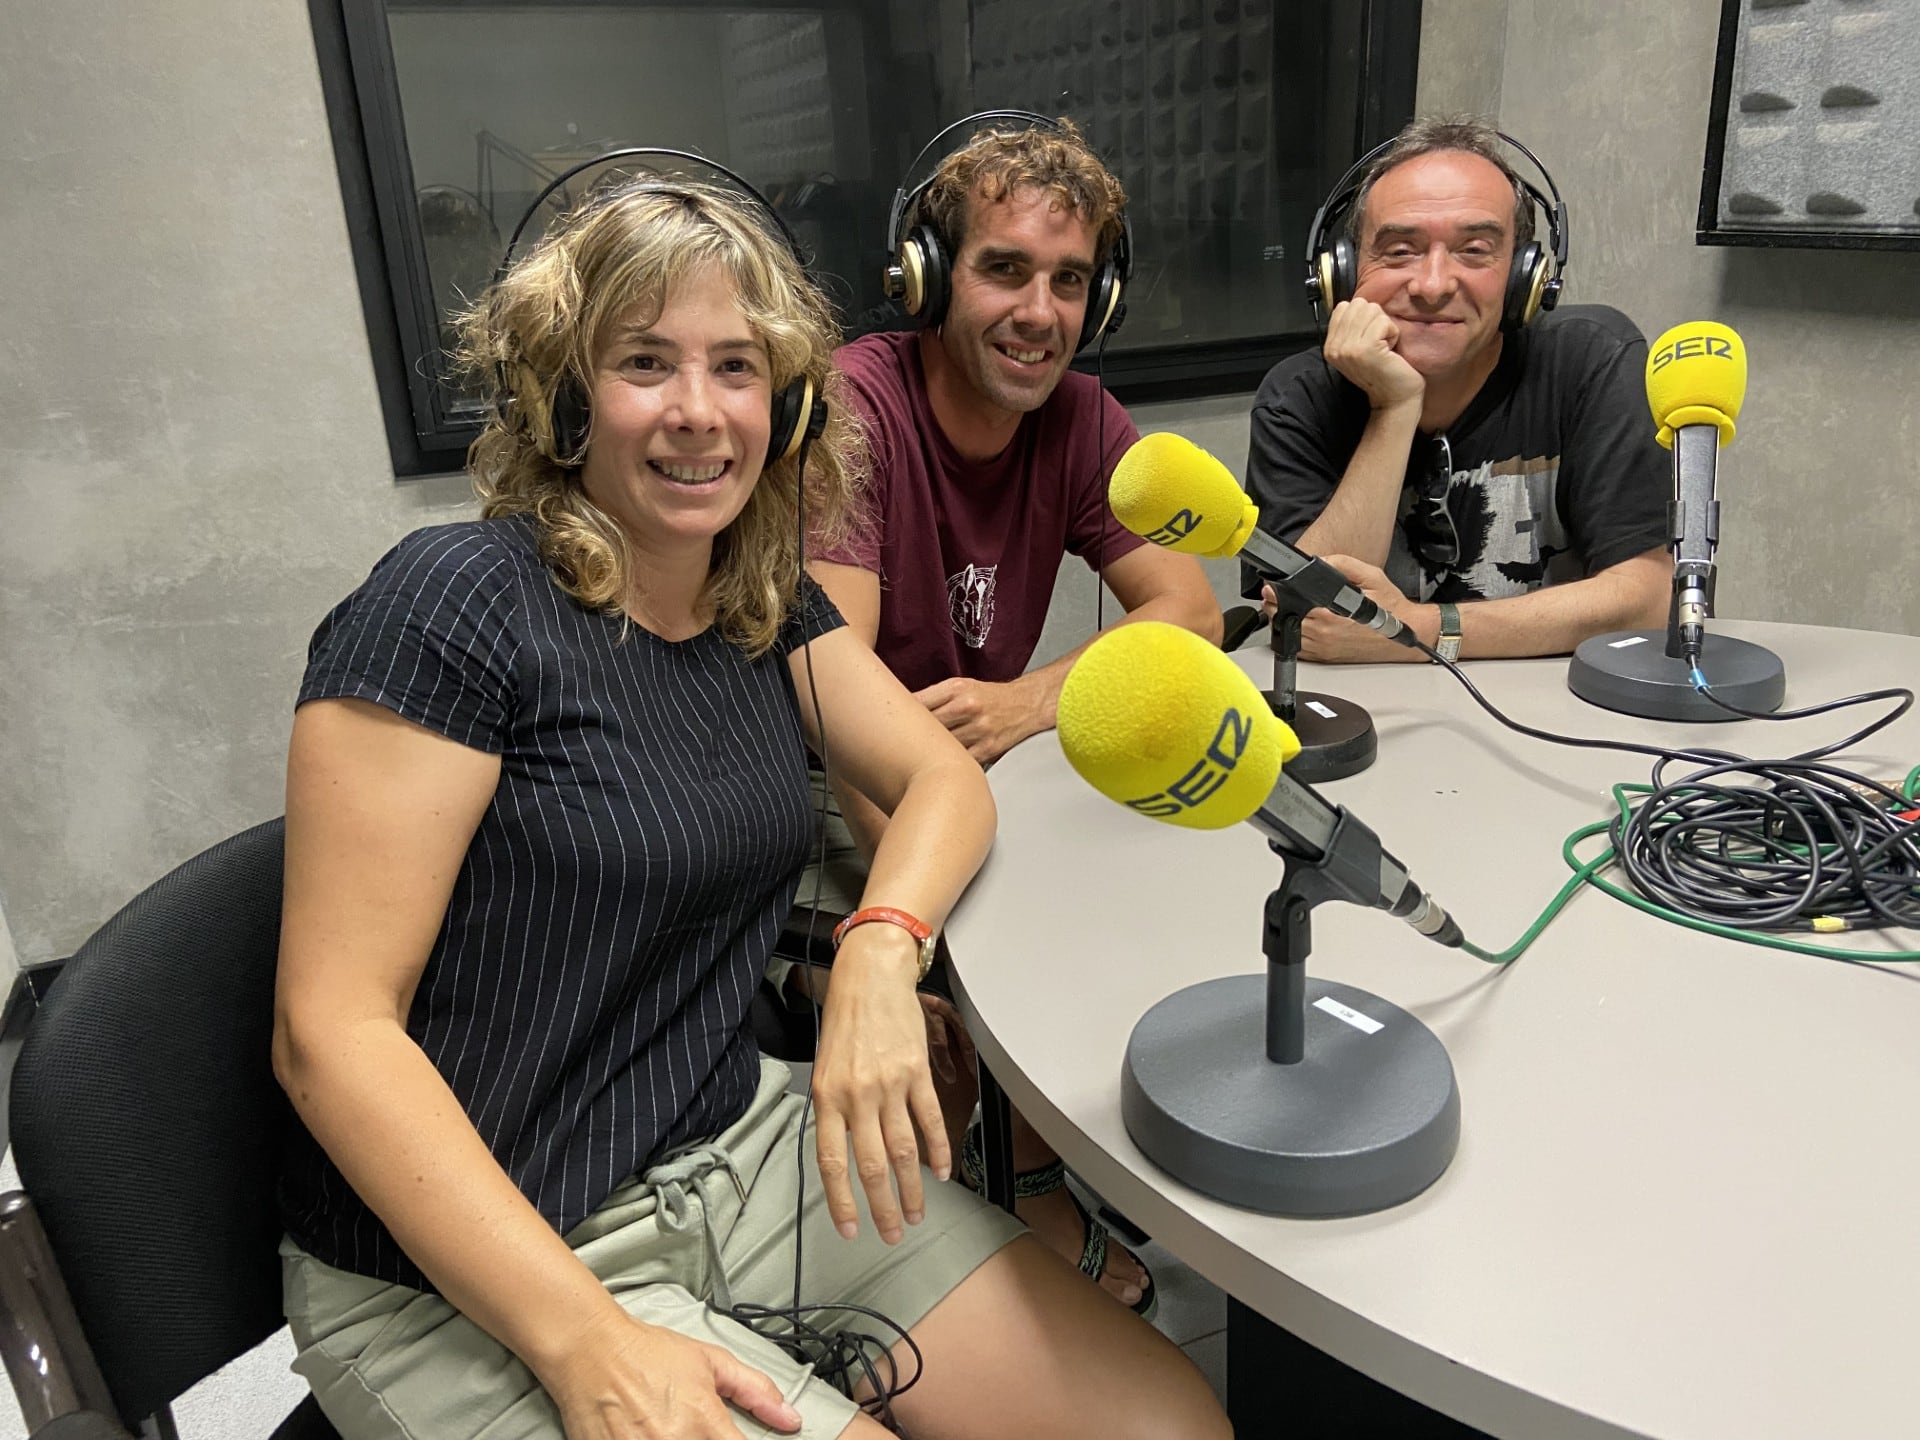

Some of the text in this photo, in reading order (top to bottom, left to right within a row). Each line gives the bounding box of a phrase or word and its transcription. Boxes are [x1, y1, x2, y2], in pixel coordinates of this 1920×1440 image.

[1652, 336, 1733, 375] SER
[1142, 508, 1203, 546] ER
[1124, 707, 1252, 817] SER
